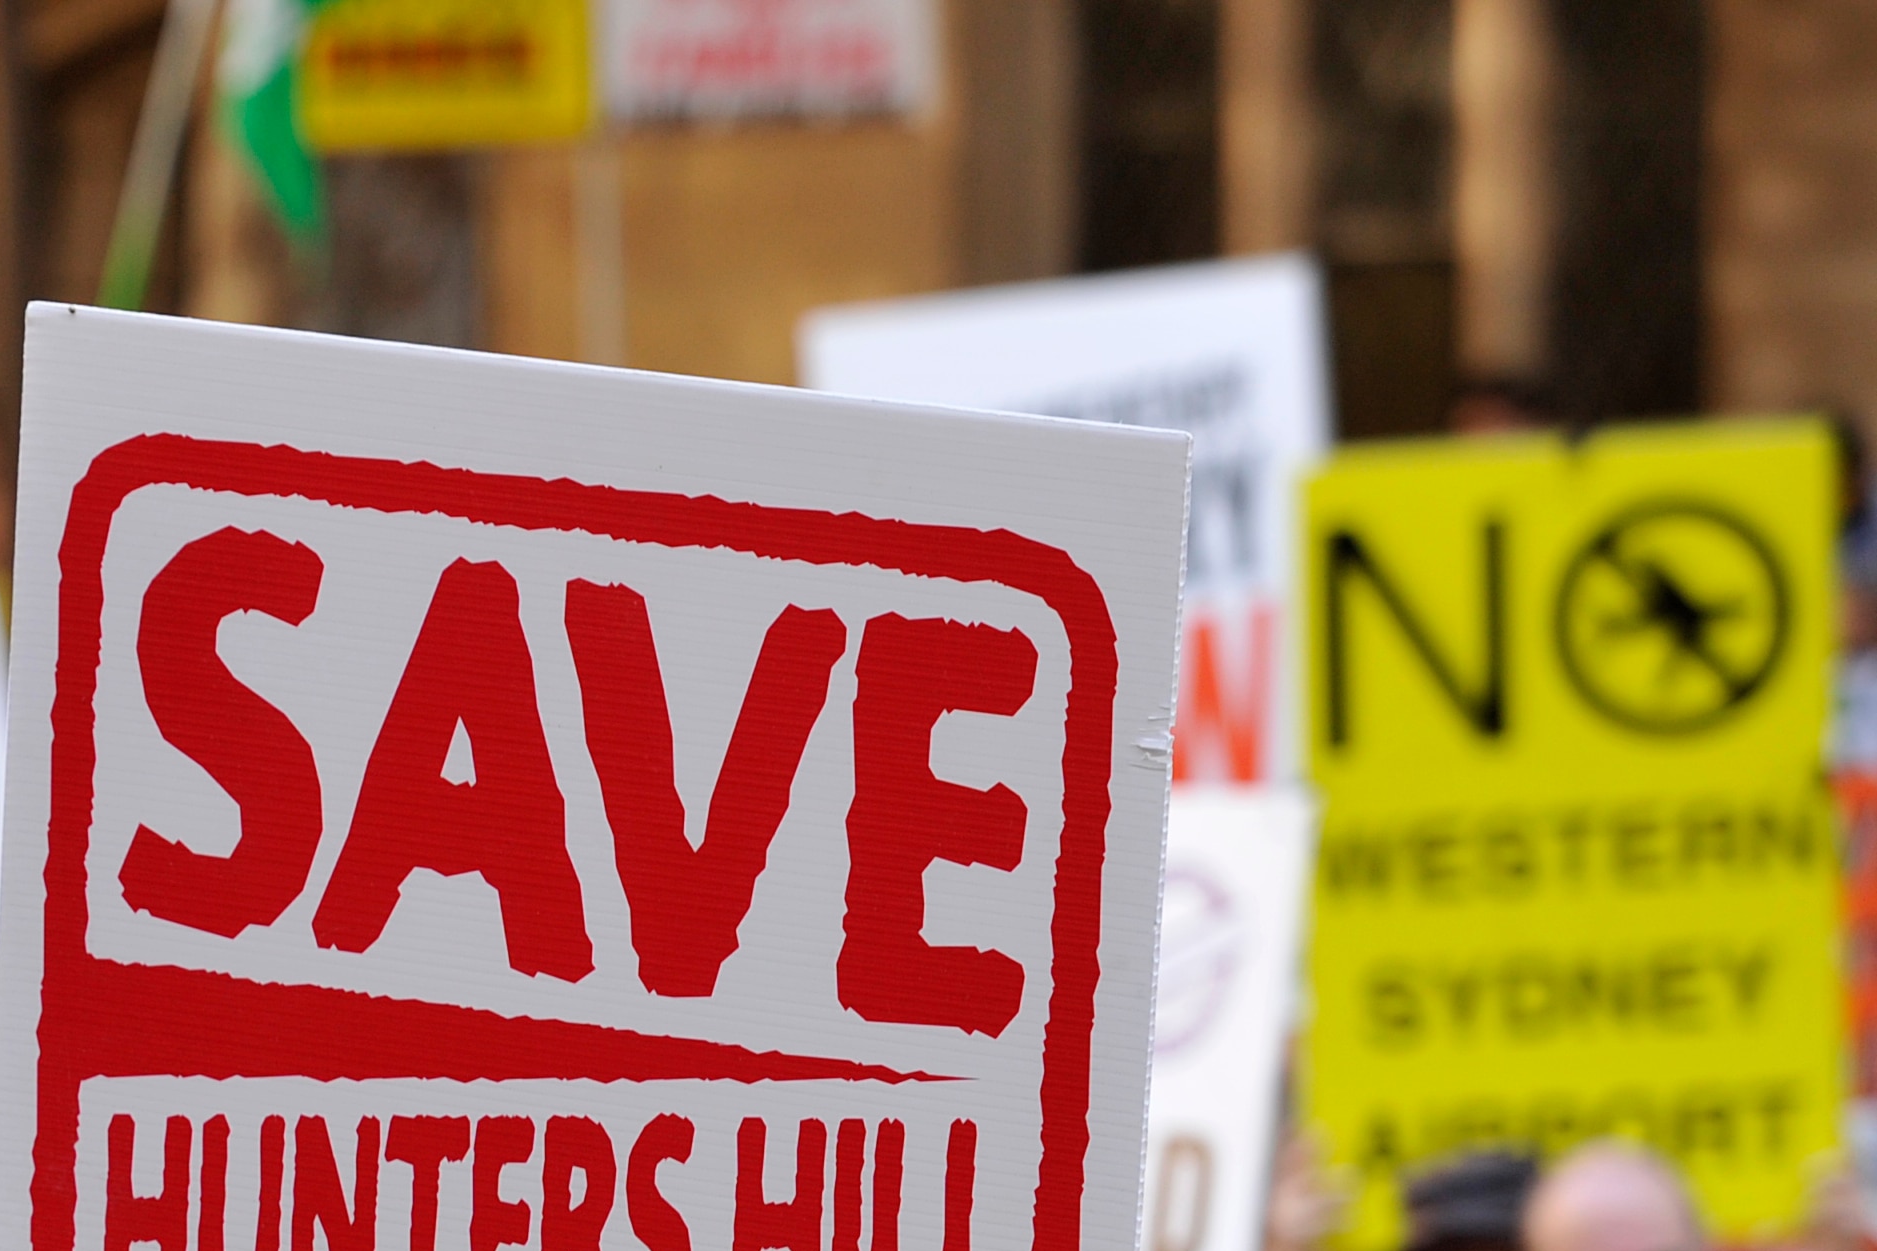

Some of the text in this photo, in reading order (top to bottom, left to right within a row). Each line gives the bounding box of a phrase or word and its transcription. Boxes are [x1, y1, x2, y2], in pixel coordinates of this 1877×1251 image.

[118, 525, 1040, 1040] SAVE
[1324, 803, 1821, 902] WESTERN
[1360, 938, 1776, 1056] SYDNEY
